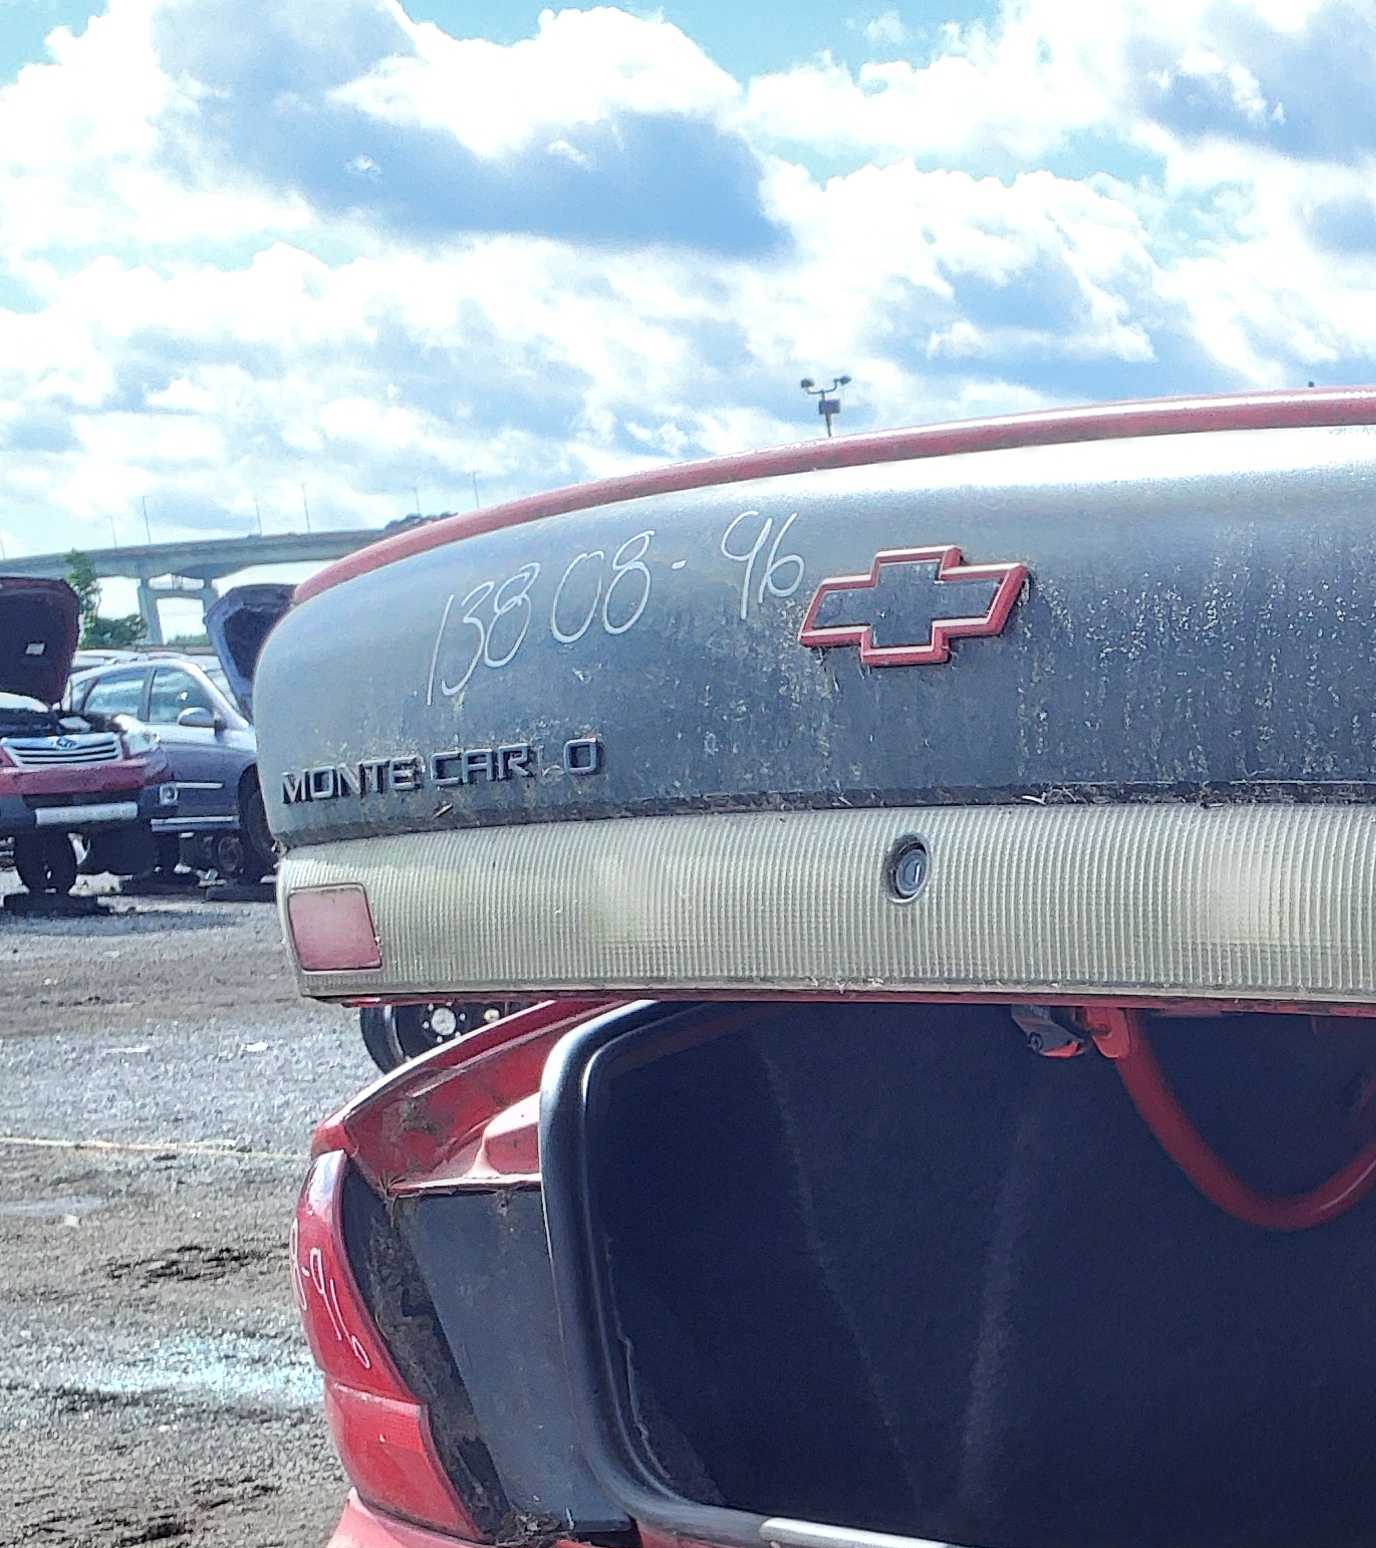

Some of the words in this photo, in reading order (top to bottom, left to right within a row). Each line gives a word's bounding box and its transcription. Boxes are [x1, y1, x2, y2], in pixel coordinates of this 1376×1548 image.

[426, 512, 805, 705] 13808-96
[281, 755, 423, 804] MONTE
[430, 738, 604, 787] CARO
